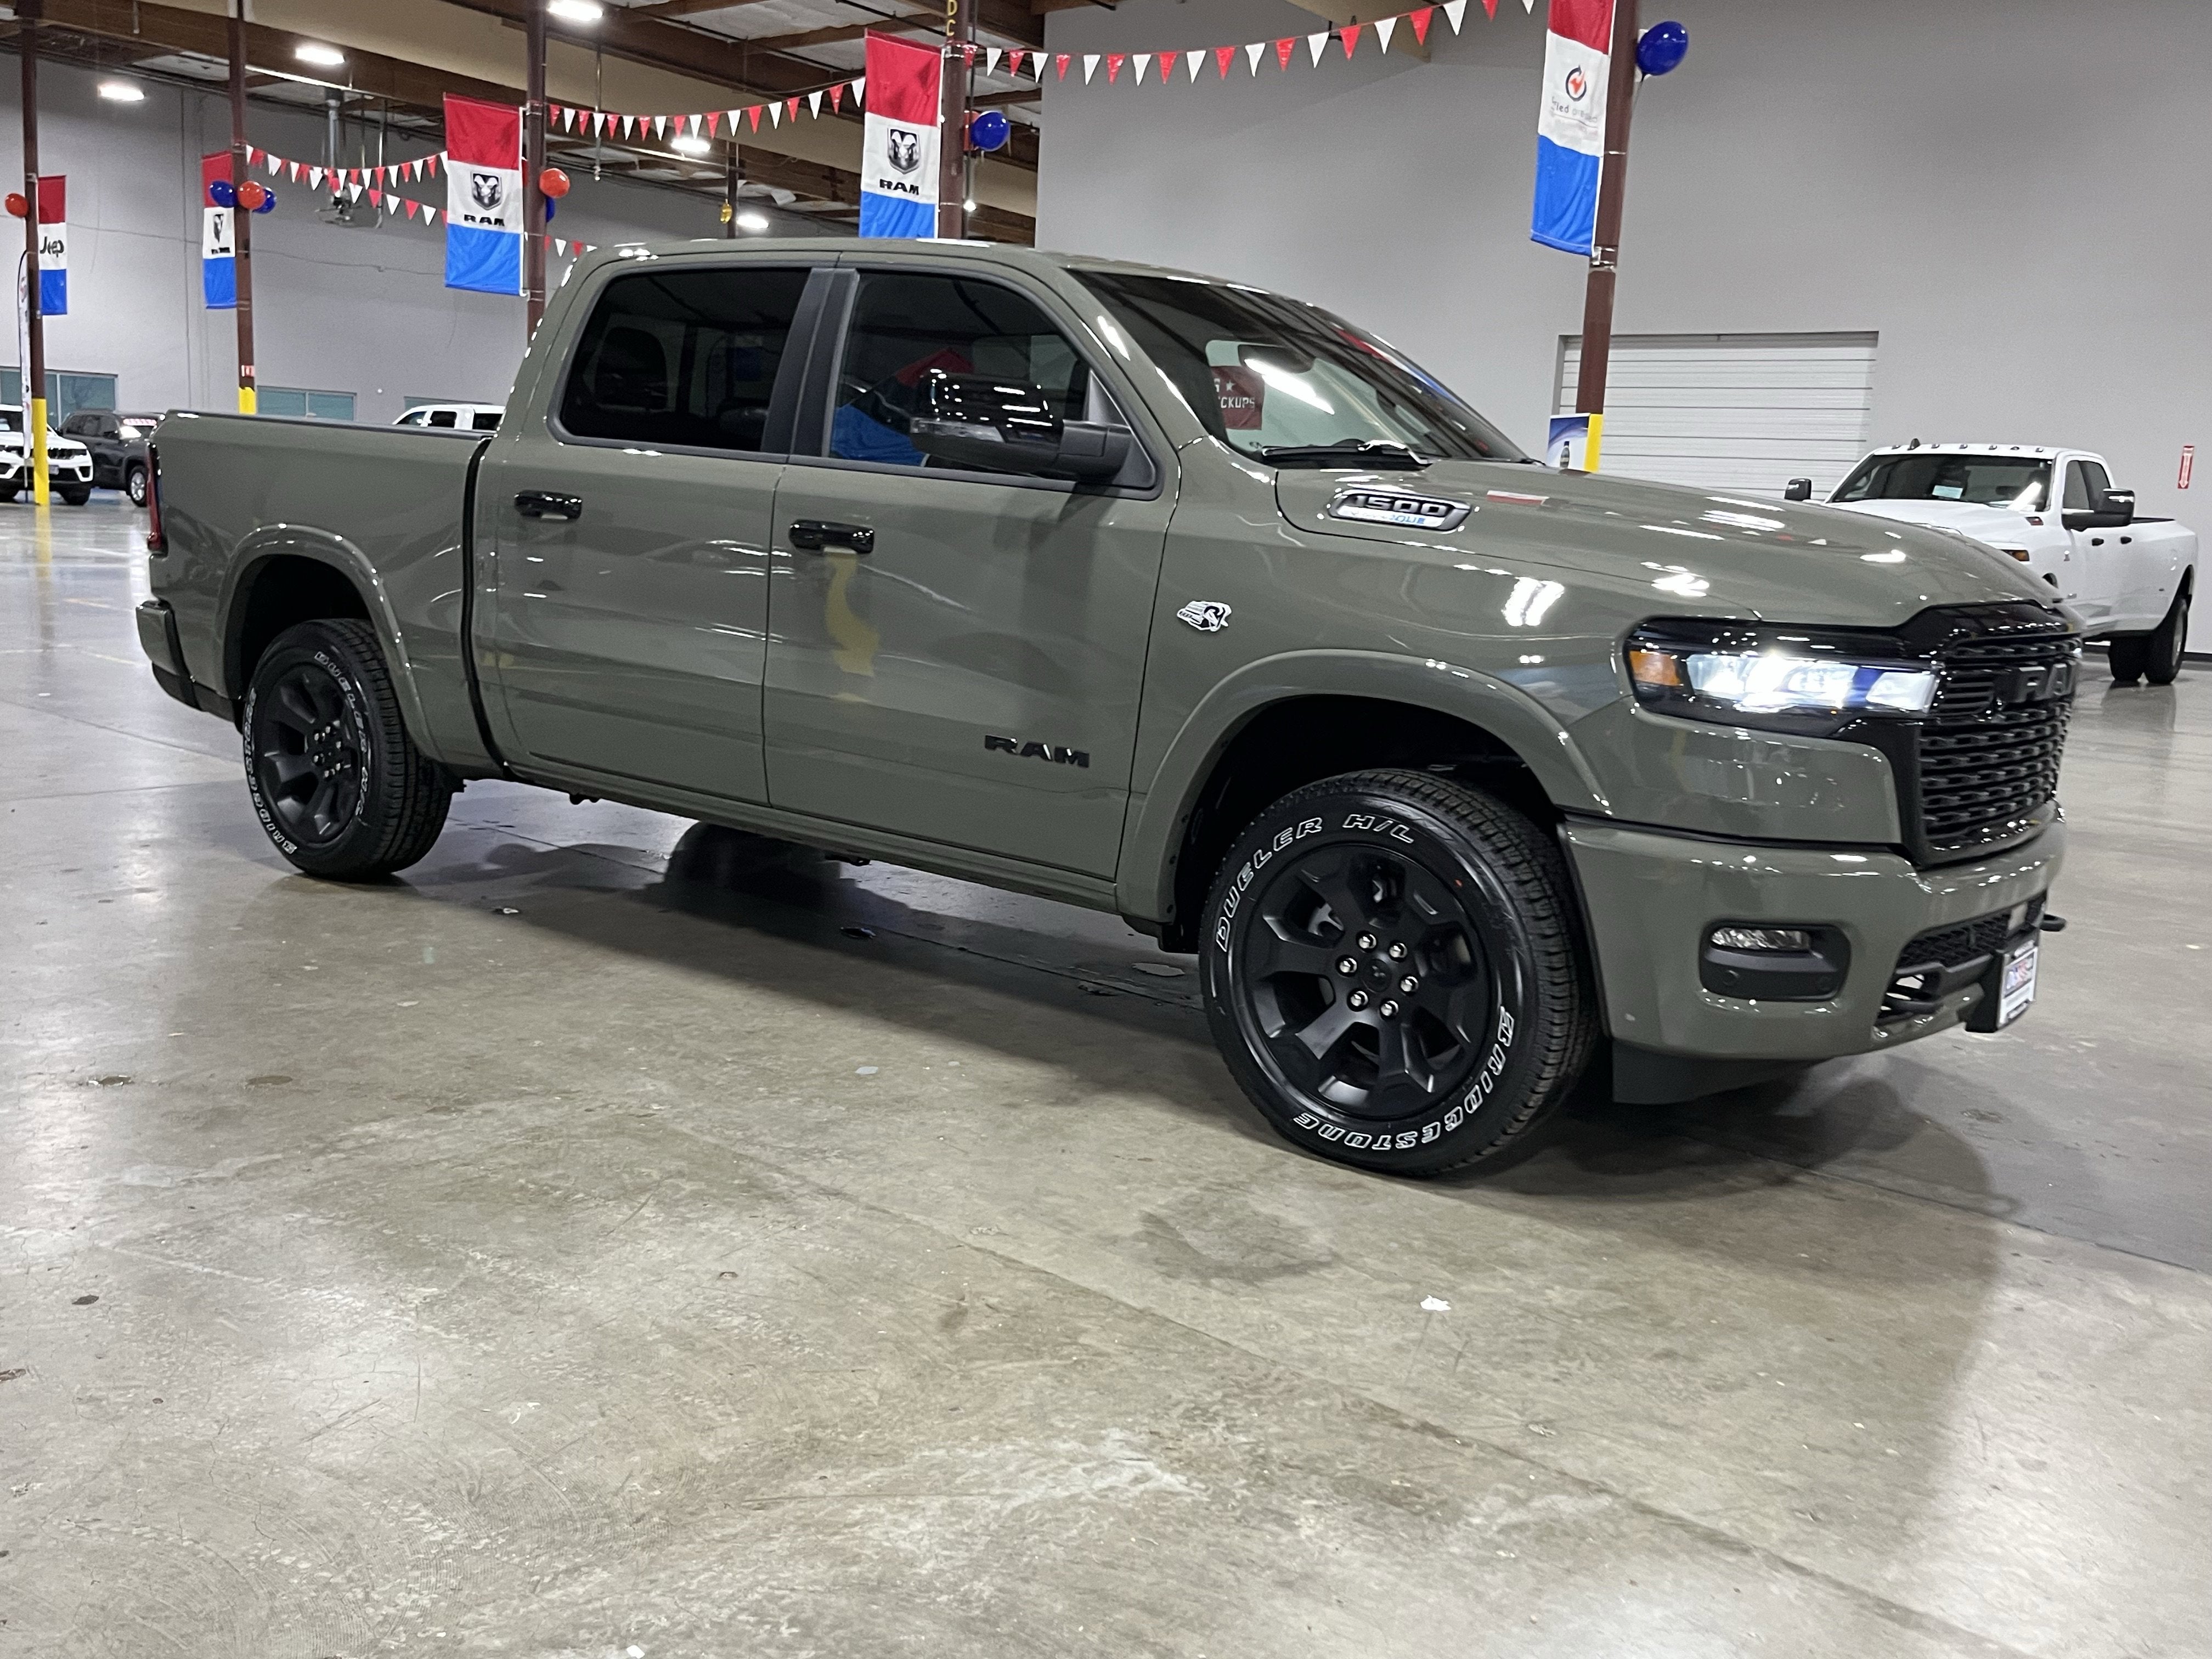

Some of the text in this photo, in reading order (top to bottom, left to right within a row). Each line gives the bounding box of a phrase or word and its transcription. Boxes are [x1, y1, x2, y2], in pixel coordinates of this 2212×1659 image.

[879, 178, 919, 195] RAM
[464, 214, 505, 227] RAM
[1353, 495, 1448, 517] 1500
[985, 735, 1090, 768] RAM
[1216, 814, 1414, 952] DUELER H/L
[1293, 1006, 1515, 1150] BRIDGESTONE
